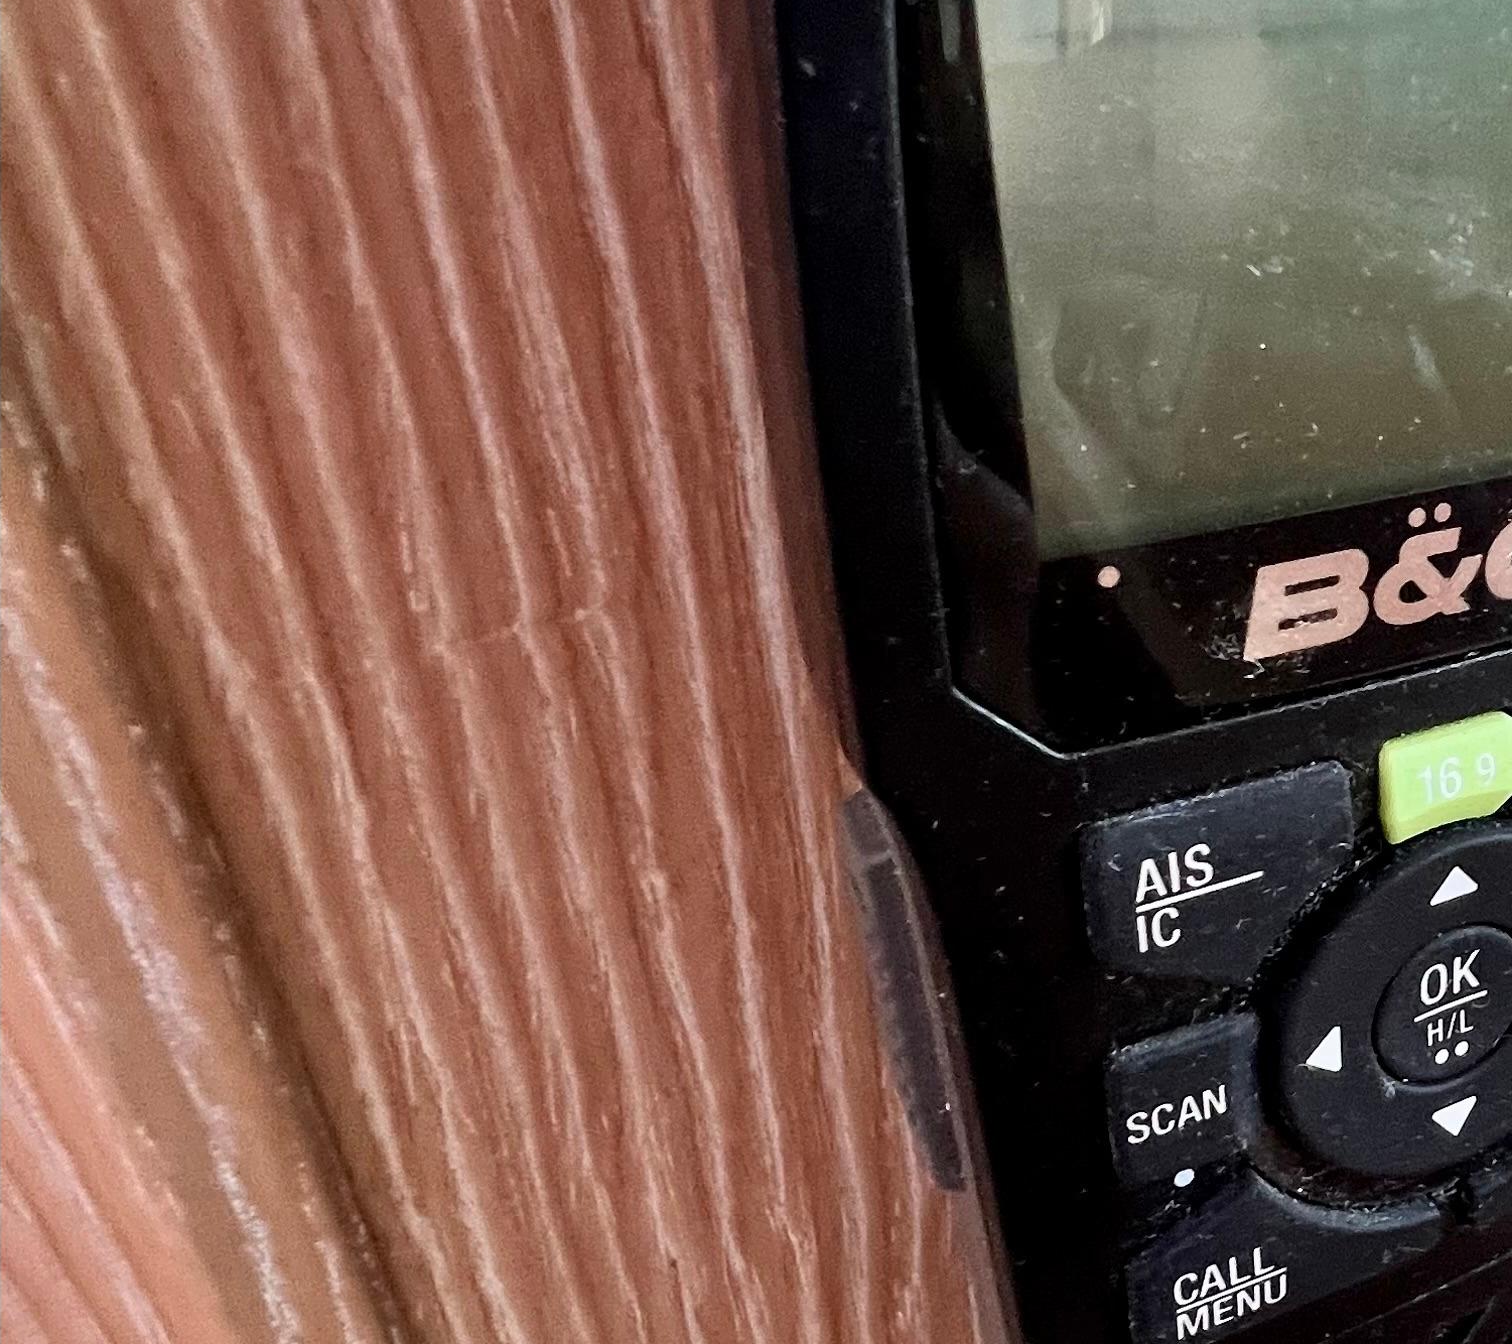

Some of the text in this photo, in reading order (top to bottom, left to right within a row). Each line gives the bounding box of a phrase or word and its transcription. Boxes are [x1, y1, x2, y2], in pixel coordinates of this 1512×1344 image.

[1416, 752, 1496, 805] 16 9
[1134, 842, 1215, 903] AIS
[1137, 906, 1182, 953] IC
[1419, 948, 1481, 1007] OK
[1426, 1008, 1474, 1047] H/L
[1125, 1085, 1227, 1145] SCAN
[1173, 1246, 1277, 1308] CALL
[1175, 1270, 1288, 1341] MENU
